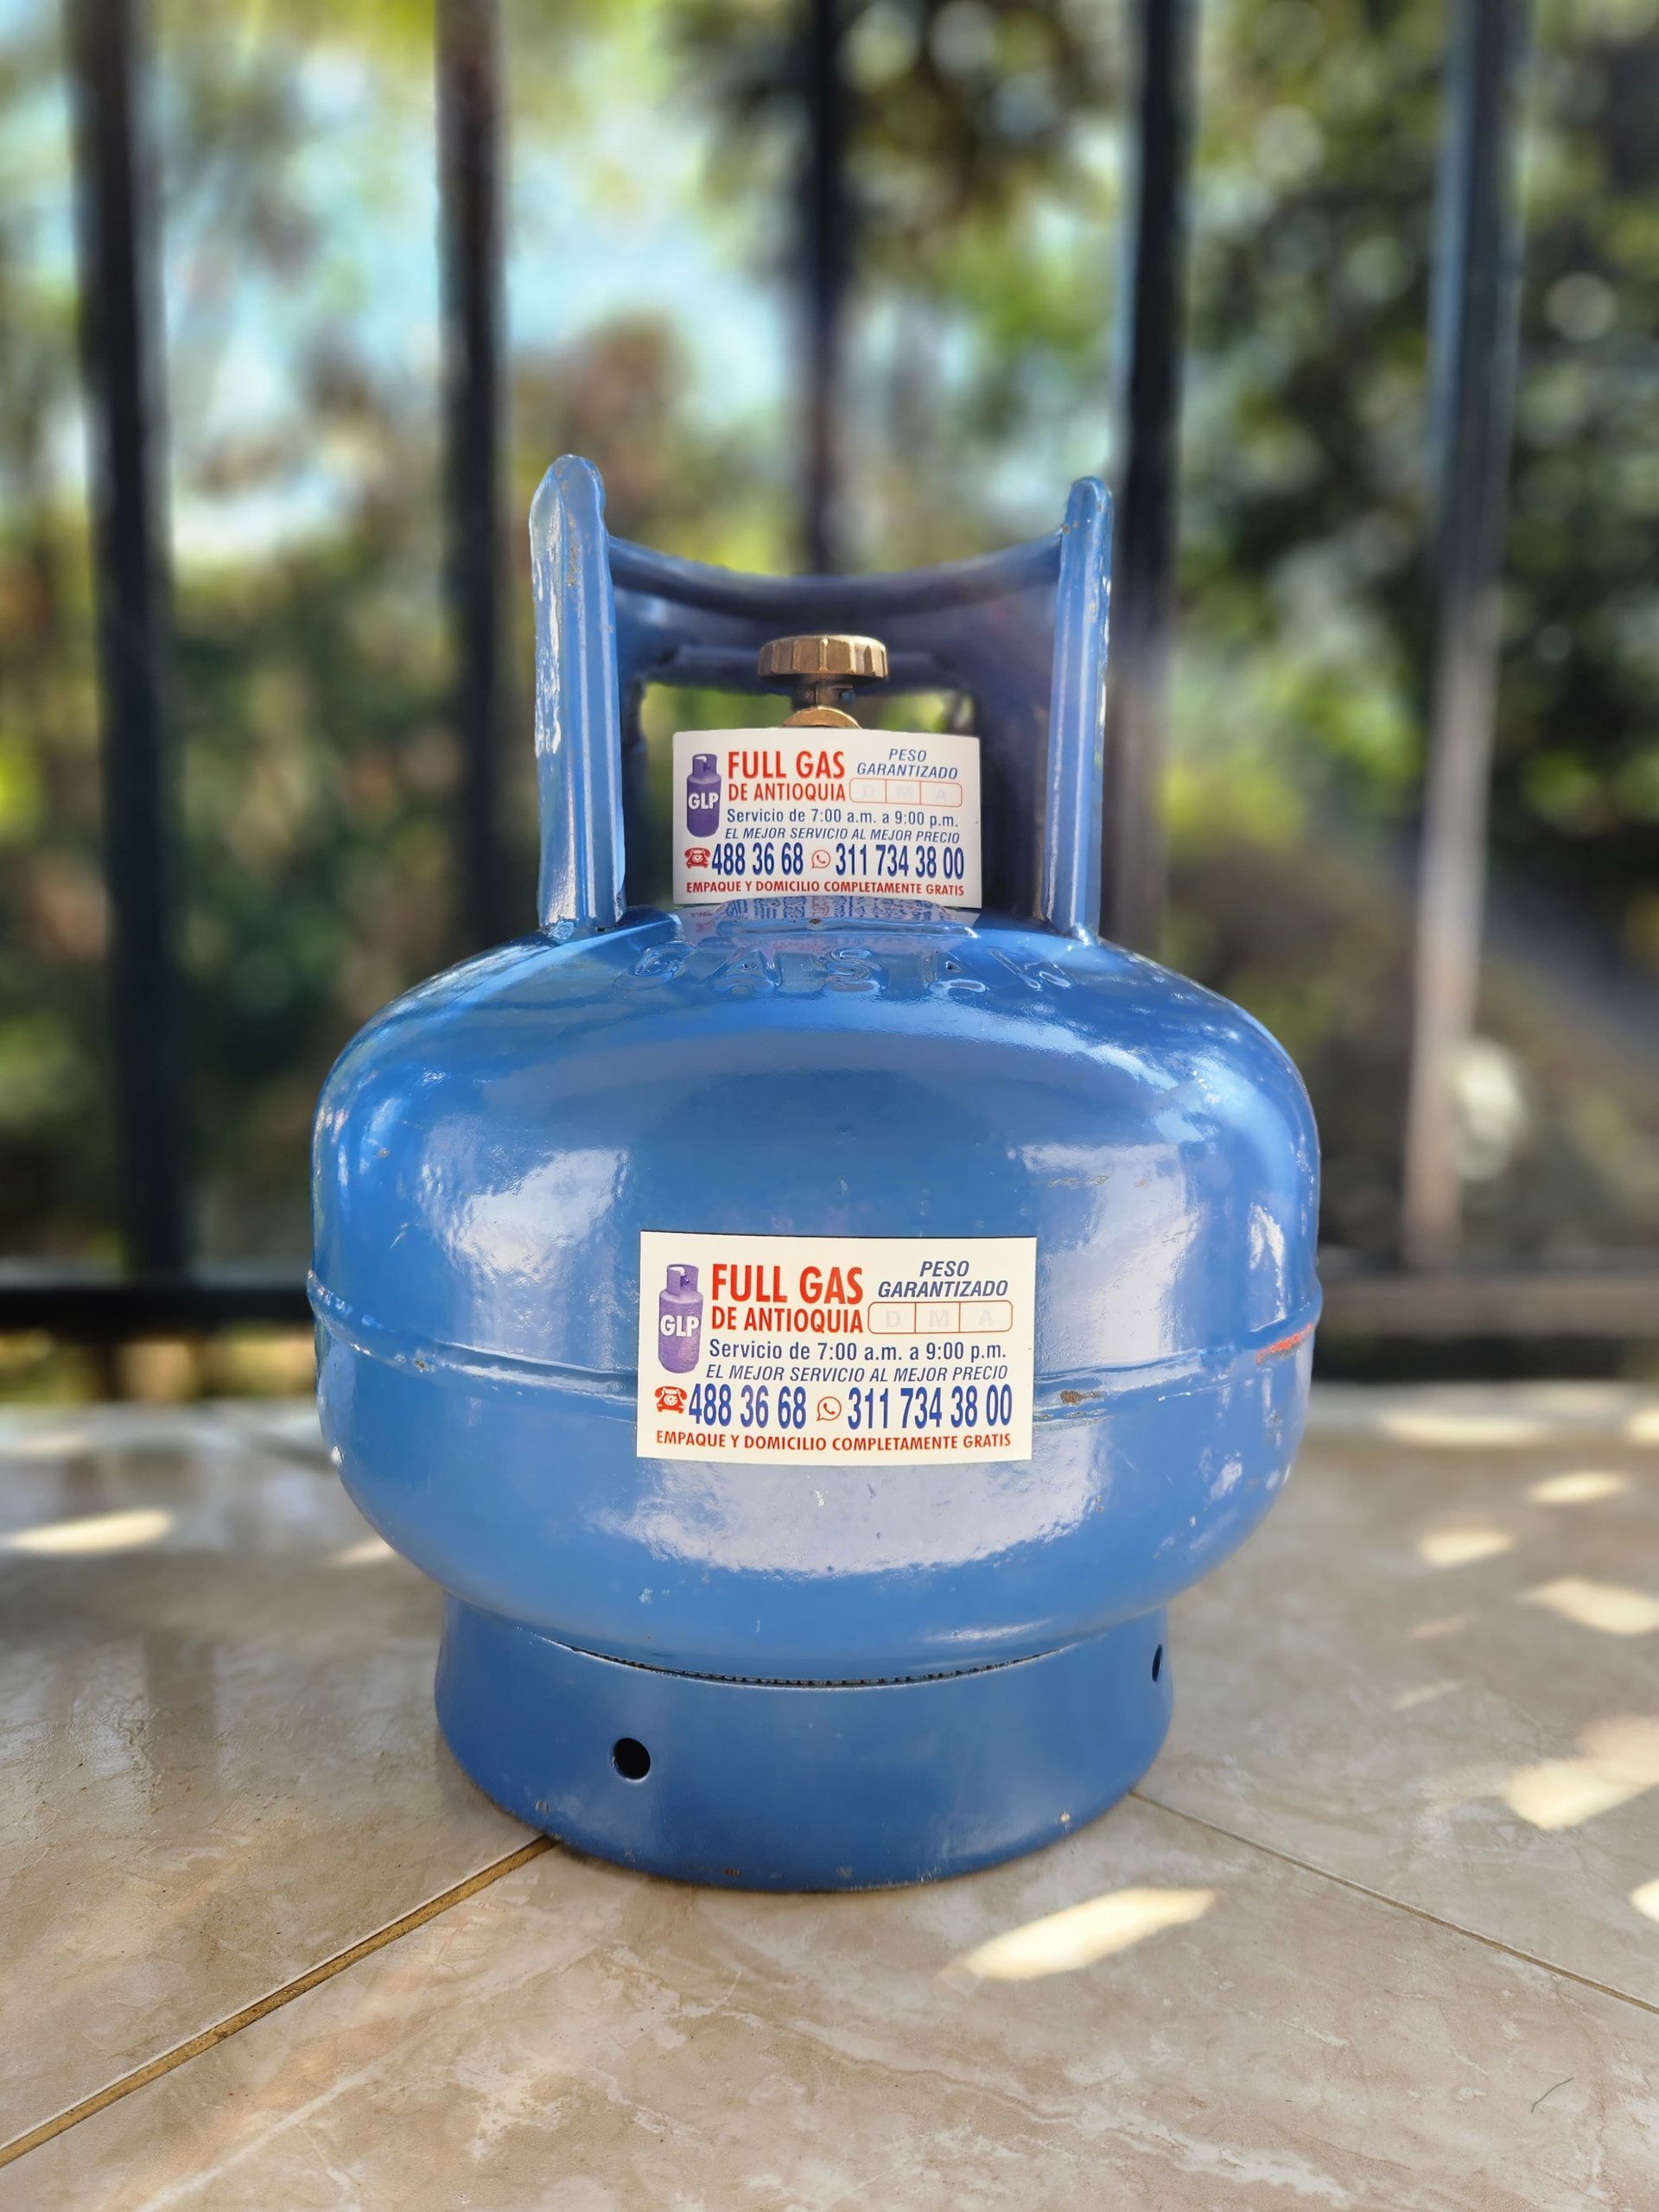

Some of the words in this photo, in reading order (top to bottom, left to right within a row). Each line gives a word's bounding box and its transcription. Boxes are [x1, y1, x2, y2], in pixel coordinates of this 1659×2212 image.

[889, 749, 926, 761] PESO
[728, 751, 786, 779] FULL
[796, 751, 844, 779] GAS
[857, 763, 957, 779] GARANTIZADO
[729, 784, 747, 801] DE
[754, 783, 845, 801] ANTIOQUIA
[688, 793, 719, 810] GLP
[728, 809, 783, 823] Servicio
[790, 809, 804, 822] de
[811, 809, 841, 822] 7:00
[848, 812, 873, 823] a.m.
[882, 814, 888, 823] a
[895, 811, 924, 824] 9:00
[931, 816, 955, 828] p.m.
[726, 829, 738, 839] EL
[743, 828, 785, 838] MEJOR
[791, 828, 848, 839] SERVICIO
[852, 829, 865, 839] AL
[871, 830, 912, 841] MEJOR
[917, 831, 959, 843] PRECIO
[712, 842, 745, 875] 488
[753, 842, 774, 875] 36
[781, 842, 804, 875] 68
[836, 843, 867, 875] 311
[876, 844, 908, 877] 734
[916, 846, 937, 878] 38
[944, 847, 963, 880] 00
[687, 881, 741, 893] EMPAQUE
[746, 881, 752, 891] Y
[756, 881, 819, 891] DOMICILIO
[824, 881, 921, 893] COMPLETAMENTE
[926, 885, 963, 895] GRATIS
[919, 1261, 969, 1277] PESO
[712, 1264, 787, 1303] FULL
[800, 1267, 862, 1305] GAS
[879, 1281, 1007, 1297] GARANTIZADO
[660, 1314, 700, 1338] GLP
[712, 1306, 736, 1330] DE
[744, 1307, 863, 1333] ANTIOQUIA
[885, 1309, 900, 1327] D
[929, 1309, 950, 1327] M
[977, 1309, 994, 1327] A
[709, 1338, 782, 1358] Servicio
[790, 1342, 810, 1359] de
[818, 1343, 856, 1360] 7:00
[865, 1347, 901, 1360] a.m.
[910, 1347, 918, 1360] a
[926, 1342, 963, 1360] 9:00
[971, 1345, 1005, 1363] p.m.
[707, 1364, 722, 1378] EL
[729, 1365, 784, 1381] MEJOR
[791, 1367, 864, 1382] SERVICIO
[869, 1369, 887, 1382] AL
[893, 1368, 947, 1382] MEJOR
[952, 1365, 1007, 1381] PRECIO
[689, 1383, 731, 1427] 488
[741, 1385, 768, 1428] 36
[779, 1386, 806, 1429] 68
[848, 1387, 888, 1429] 311
[900, 1387, 942, 1429] 734
[950, 1385, 977, 1427] 38
[986, 1384, 1012, 1426] 00
[657, 1431, 725, 1447] EMPAQUE
[731, 1435, 739, 1447] Y
[745, 1435, 826, 1451] DOMICILIO
[832, 1436, 957, 1451] COMPLETAMENTE
[963, 1433, 1010, 1448] GRATIS
